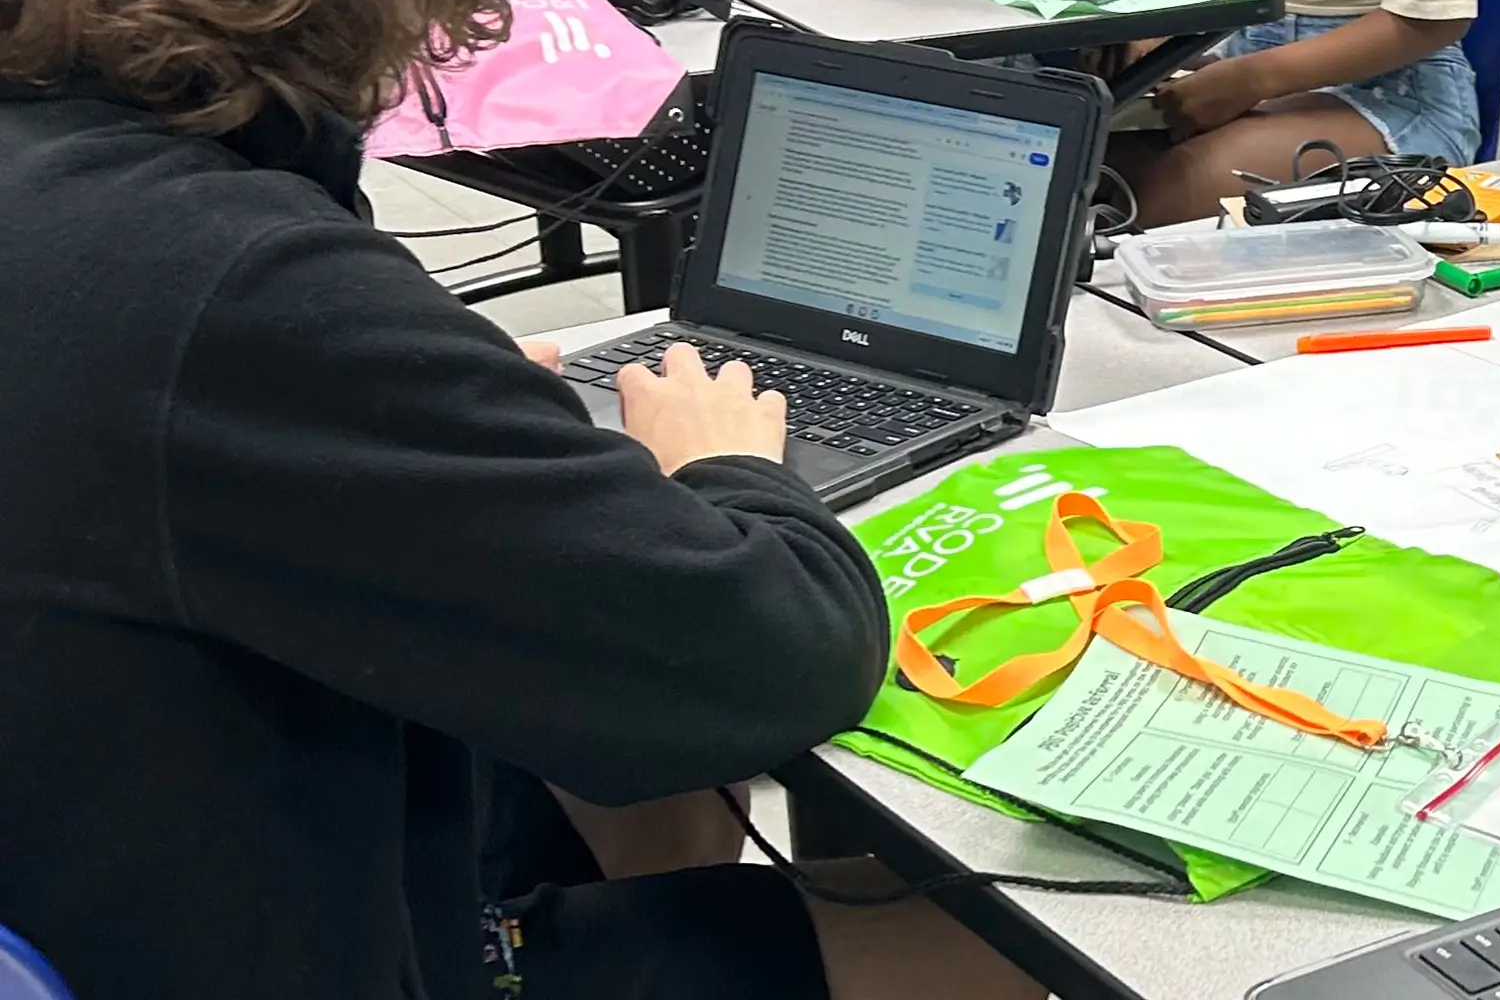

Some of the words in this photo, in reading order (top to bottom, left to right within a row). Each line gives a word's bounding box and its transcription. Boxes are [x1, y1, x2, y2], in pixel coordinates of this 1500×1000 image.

[841, 329, 870, 346] DELL
[881, 505, 978, 558] RVA
[883, 513, 1004, 600] CODE
[1053, 704, 1093, 738] Positive
[1080, 669, 1121, 708] Referral
